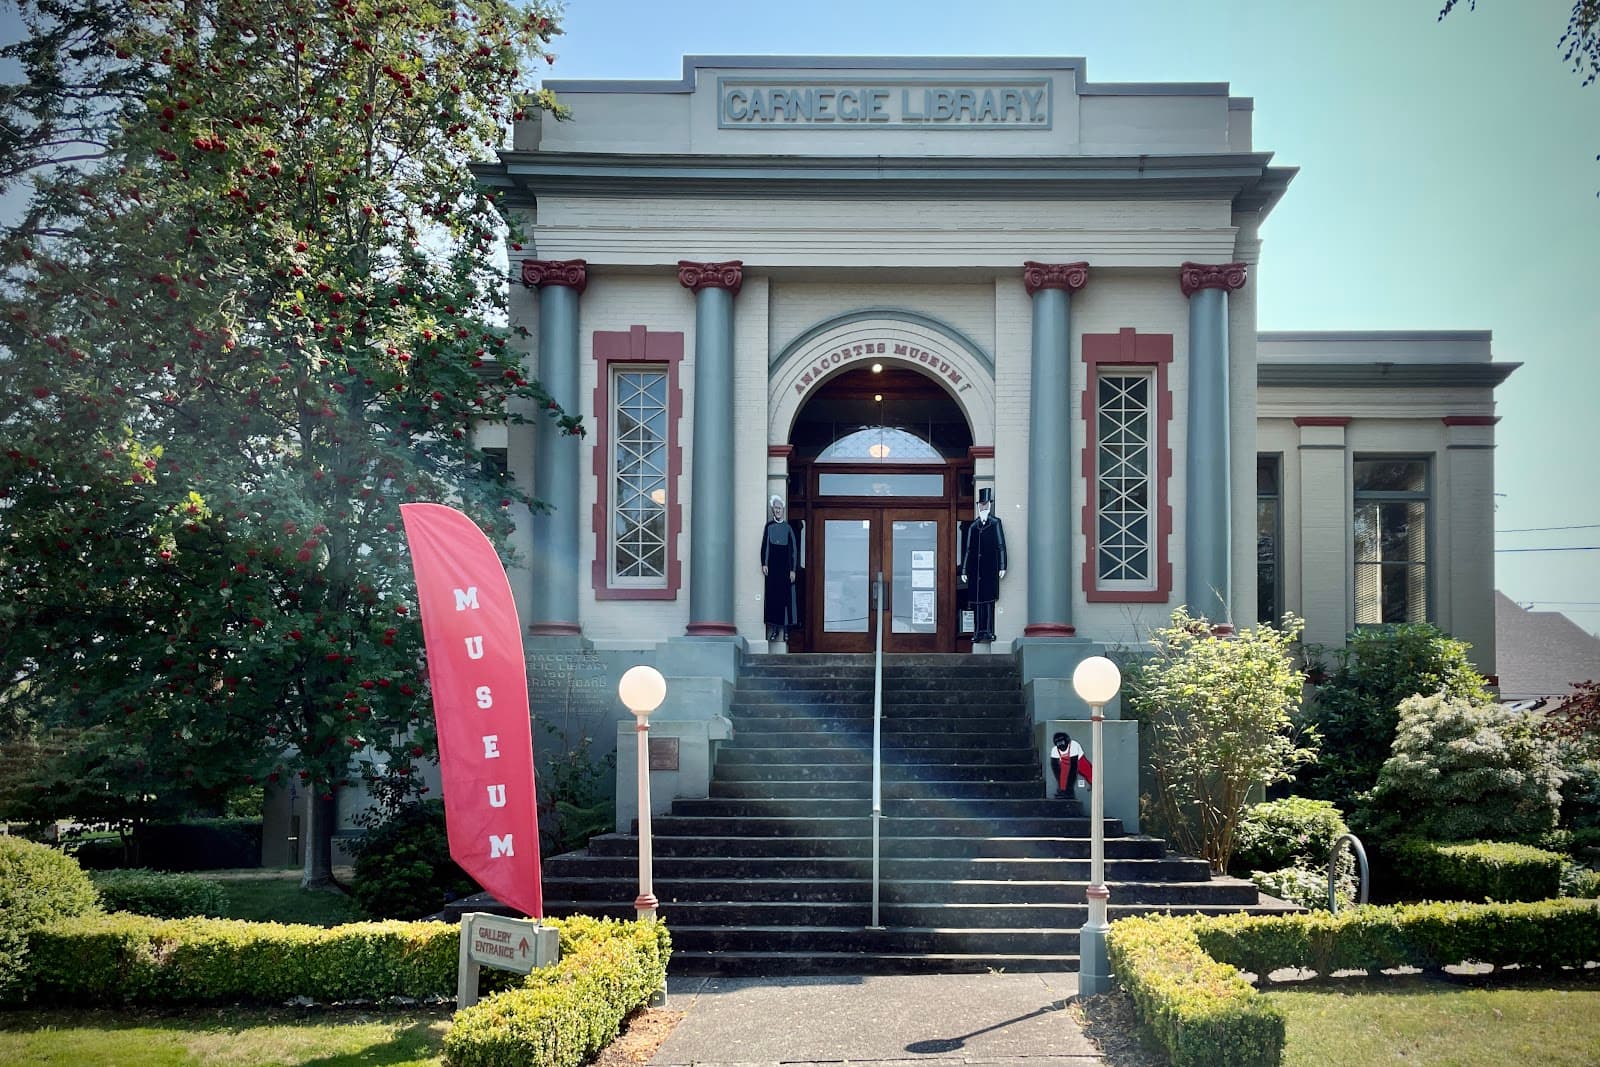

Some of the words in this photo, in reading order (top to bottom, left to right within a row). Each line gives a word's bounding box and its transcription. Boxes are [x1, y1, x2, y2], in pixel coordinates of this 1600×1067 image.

[726, 89, 889, 121] CARNEGIE
[794, 342, 886, 396] ANACORTES
[893, 343, 963, 385] MUSEUM
[454, 586, 514, 858] MUSEUM
[475, 940, 515, 959] ENTRANCE
[479, 927, 512, 944] GALLERY
